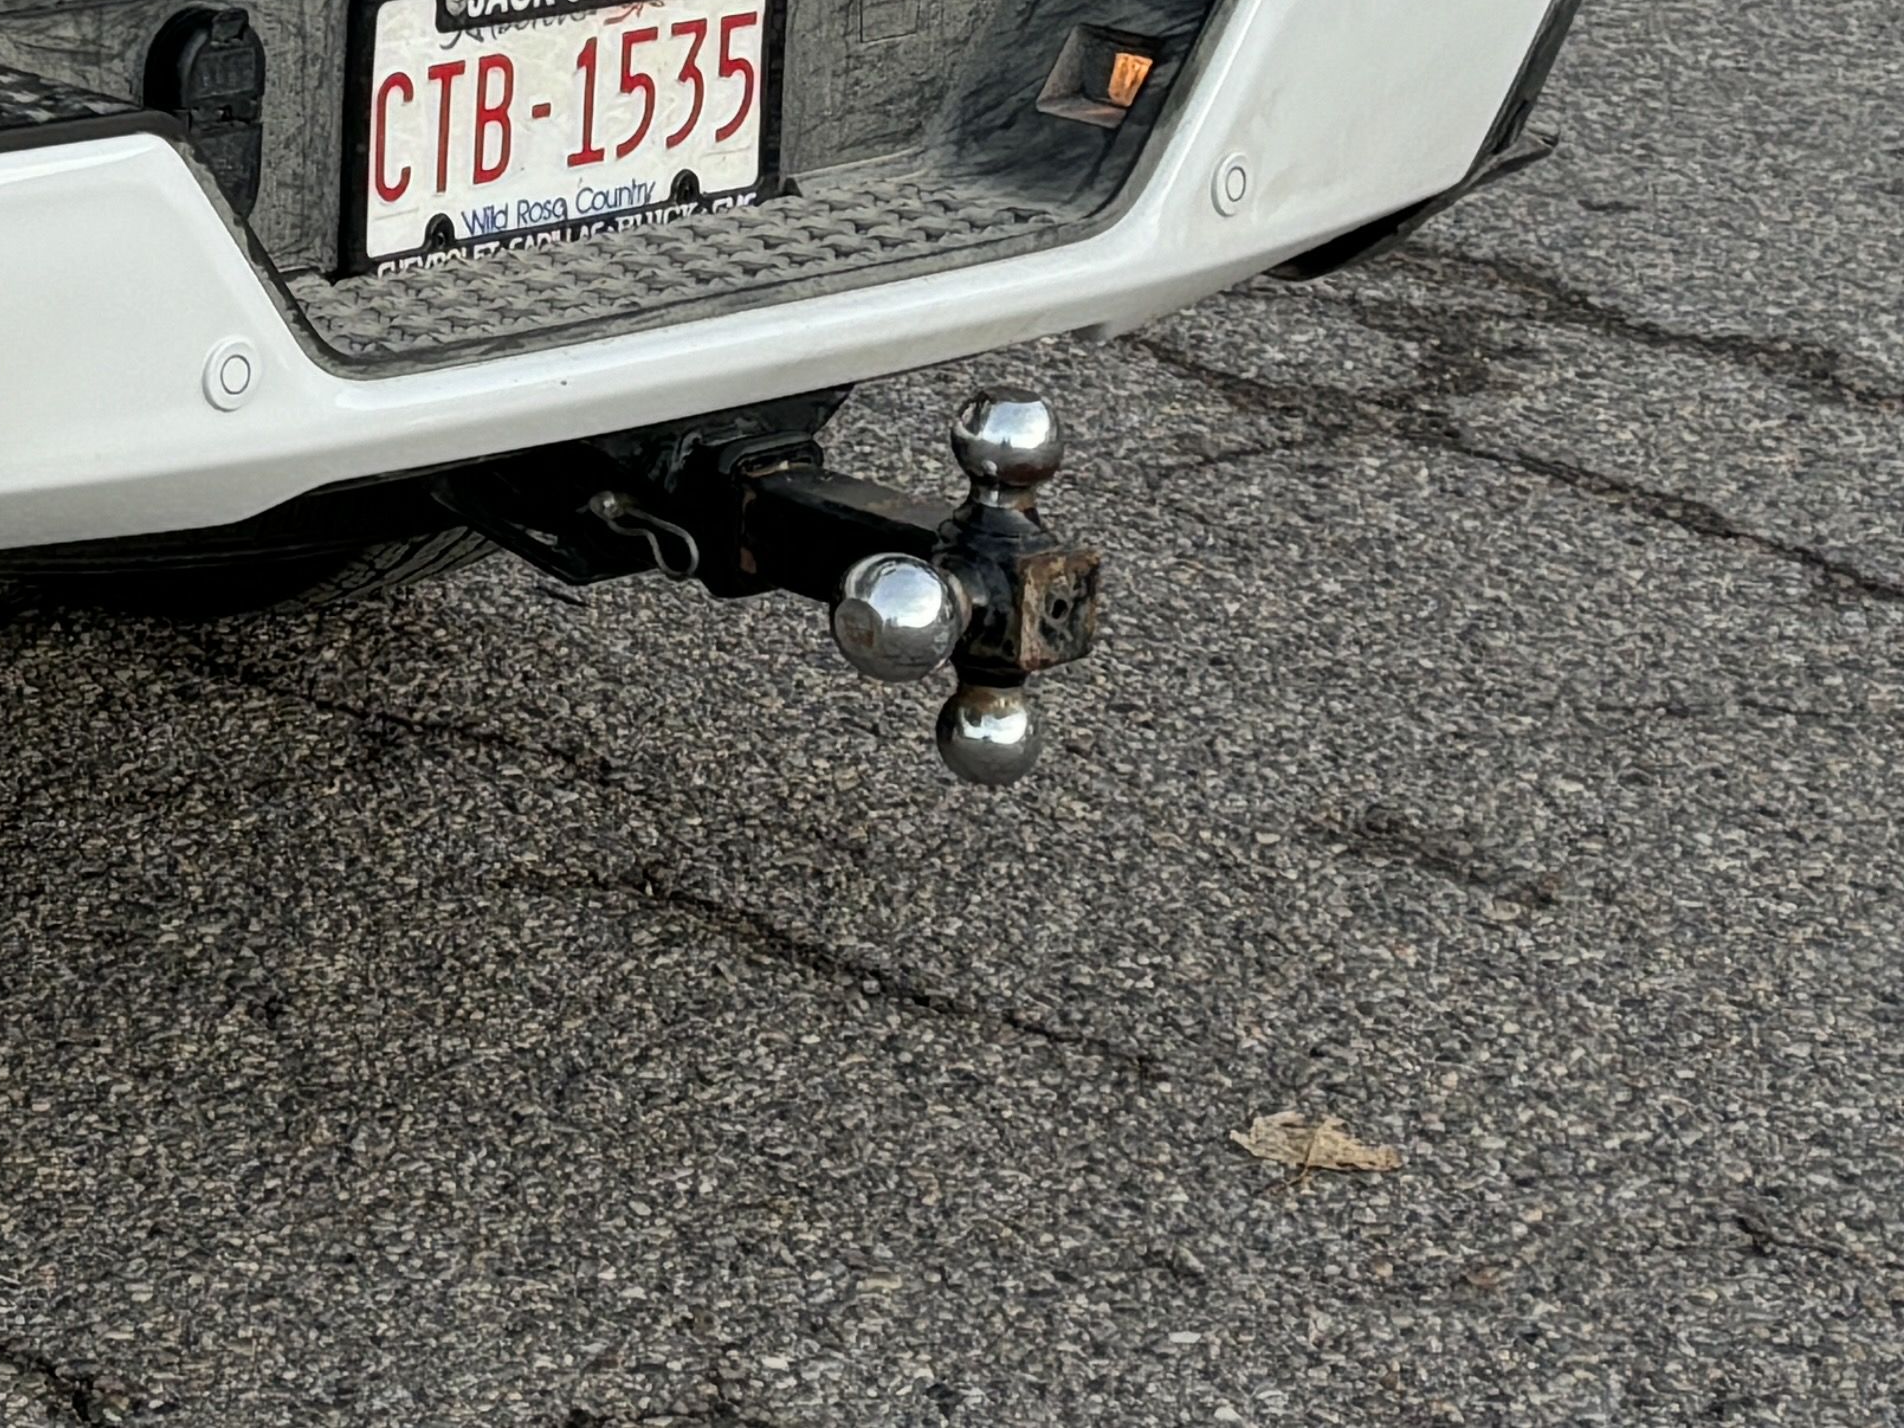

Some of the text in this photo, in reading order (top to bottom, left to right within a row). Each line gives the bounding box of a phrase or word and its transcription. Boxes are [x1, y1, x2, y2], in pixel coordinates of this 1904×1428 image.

[373, 11, 758, 203] CTB-1535
[461, 202, 509, 238] Wild
[576, 178, 658, 215] Country
